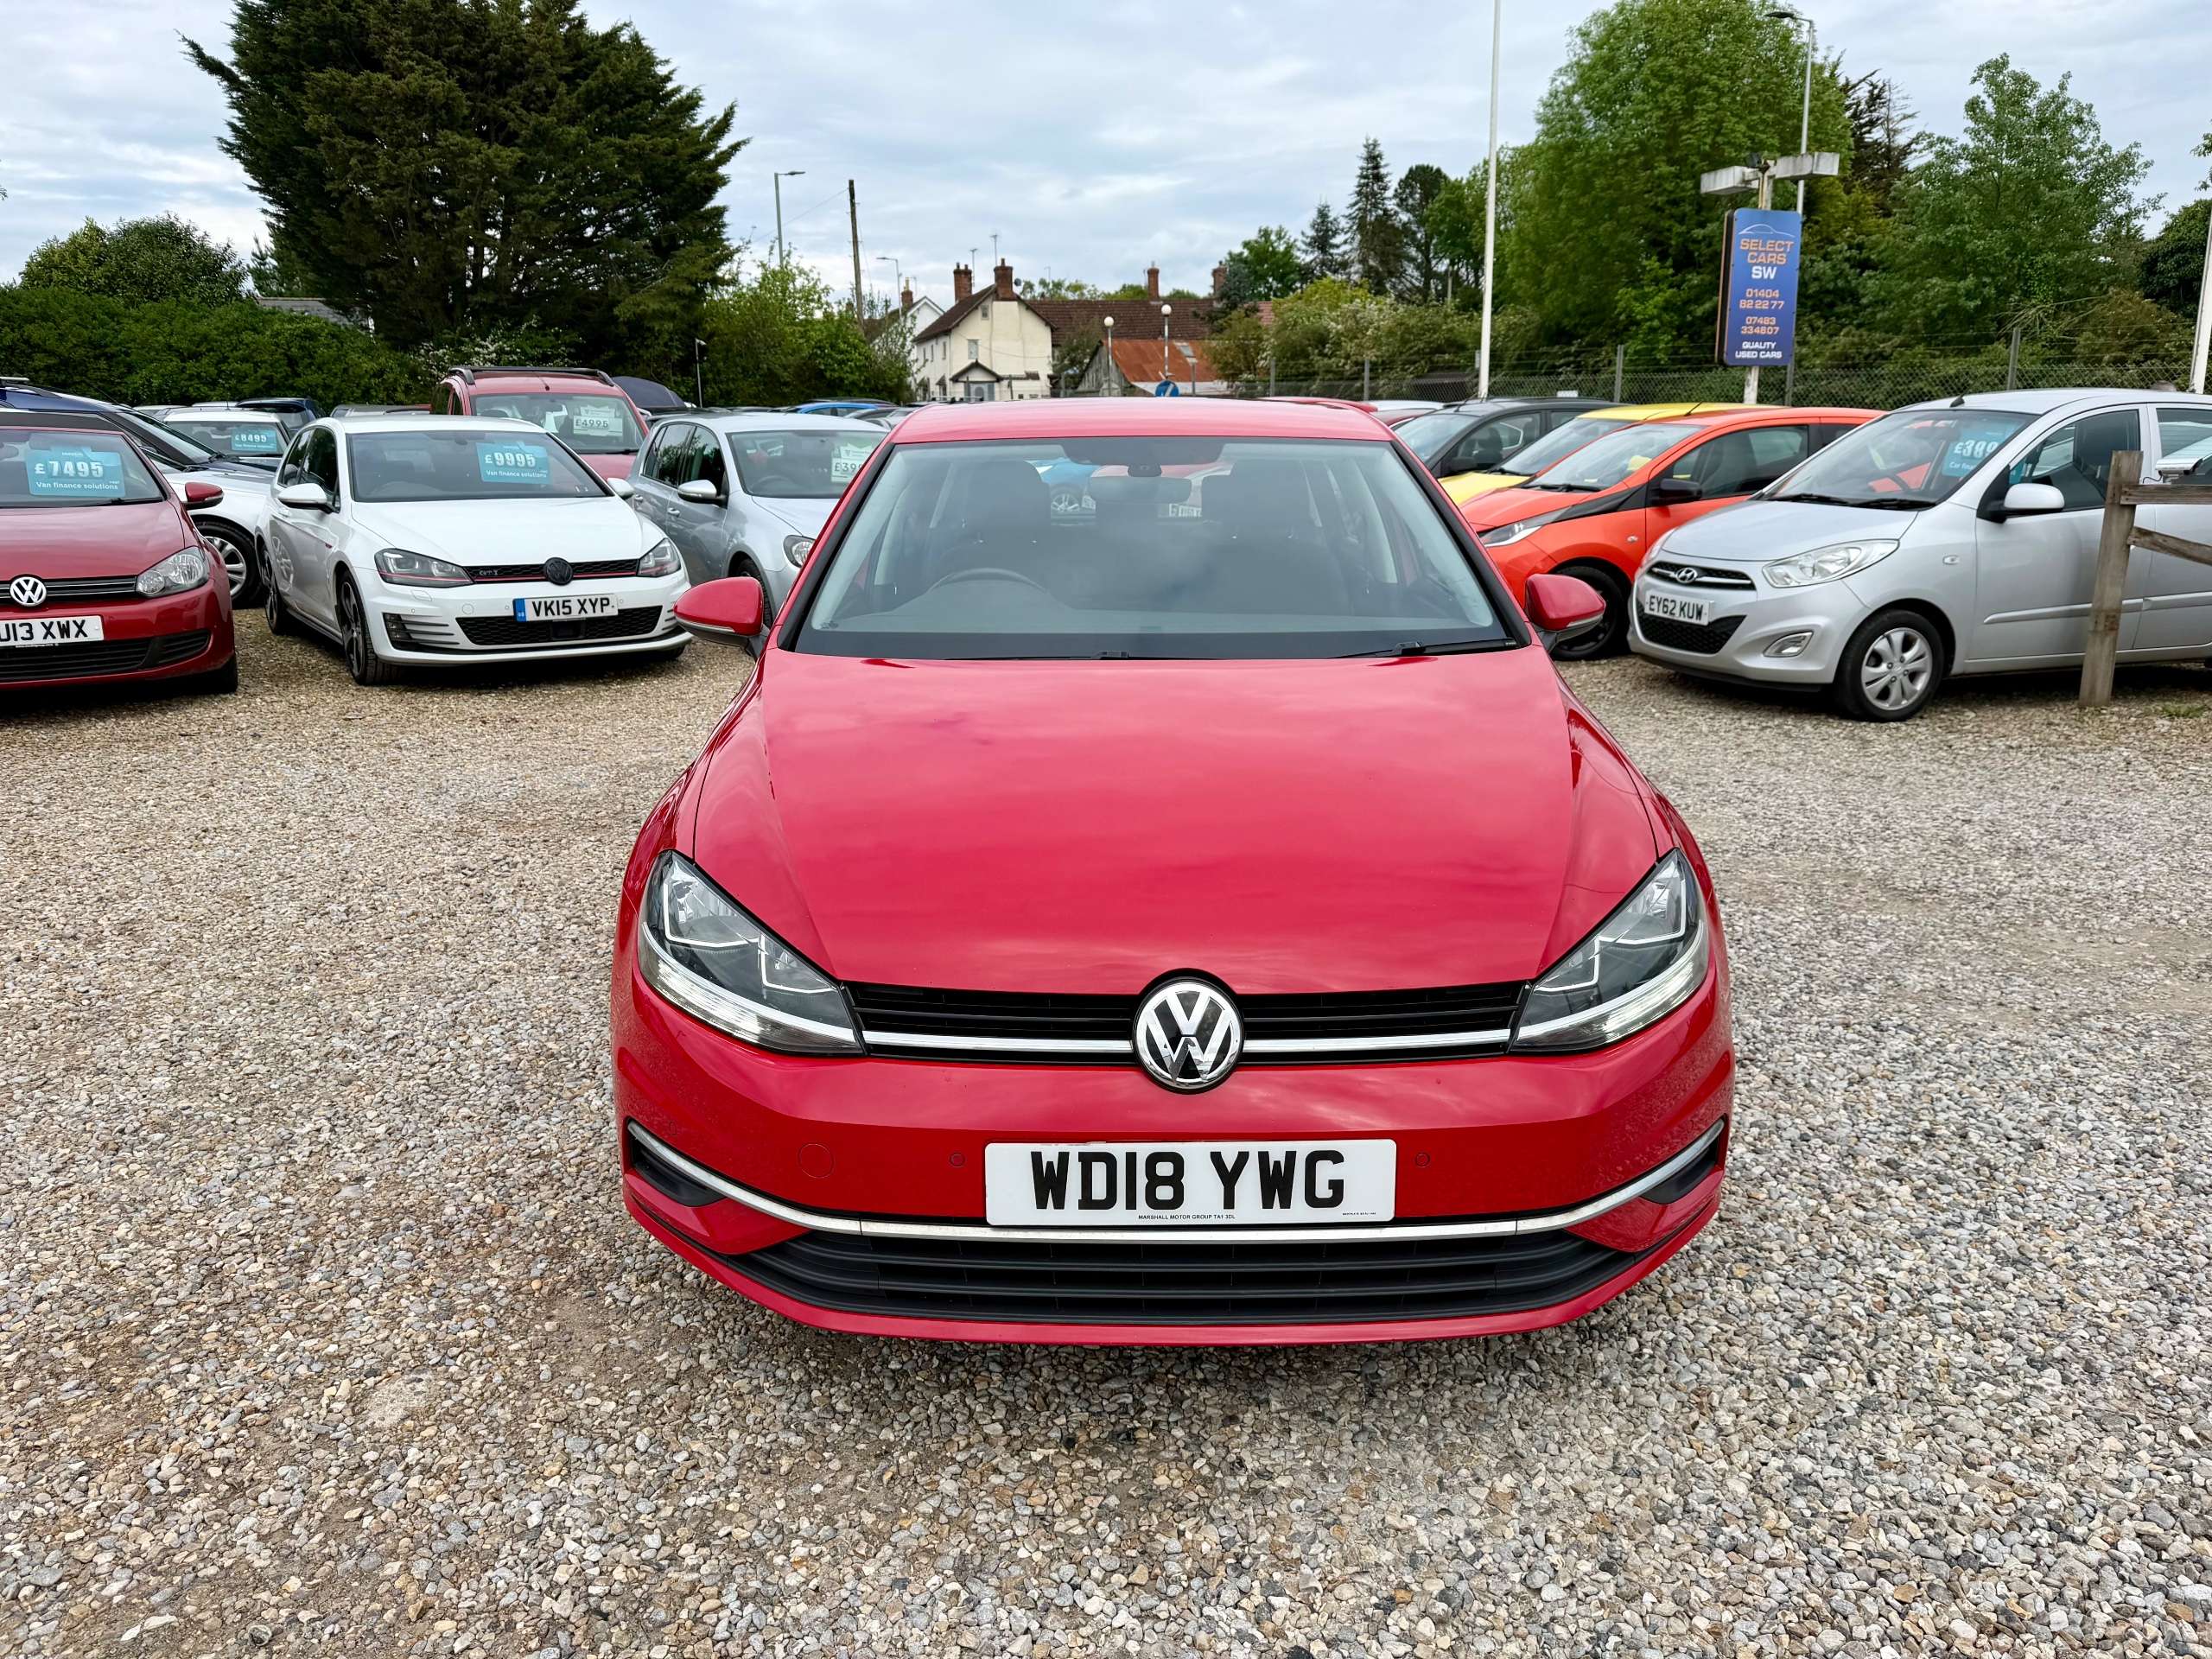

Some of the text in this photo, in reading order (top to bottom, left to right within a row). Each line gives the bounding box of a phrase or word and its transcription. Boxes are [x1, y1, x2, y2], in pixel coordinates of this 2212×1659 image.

[1739, 238, 1795, 252] SELECT
[1747, 251, 1787, 264] CARS
[1751, 266, 1777, 279] SW
[1745, 289, 1780, 298] 01404
[531, 597, 610, 617] VK15 XYP
[1649, 595, 1703, 621] EY62 KUW
[41, 620, 88, 640] XWX
[1031, 1150, 1344, 1211] WD18 YWG
